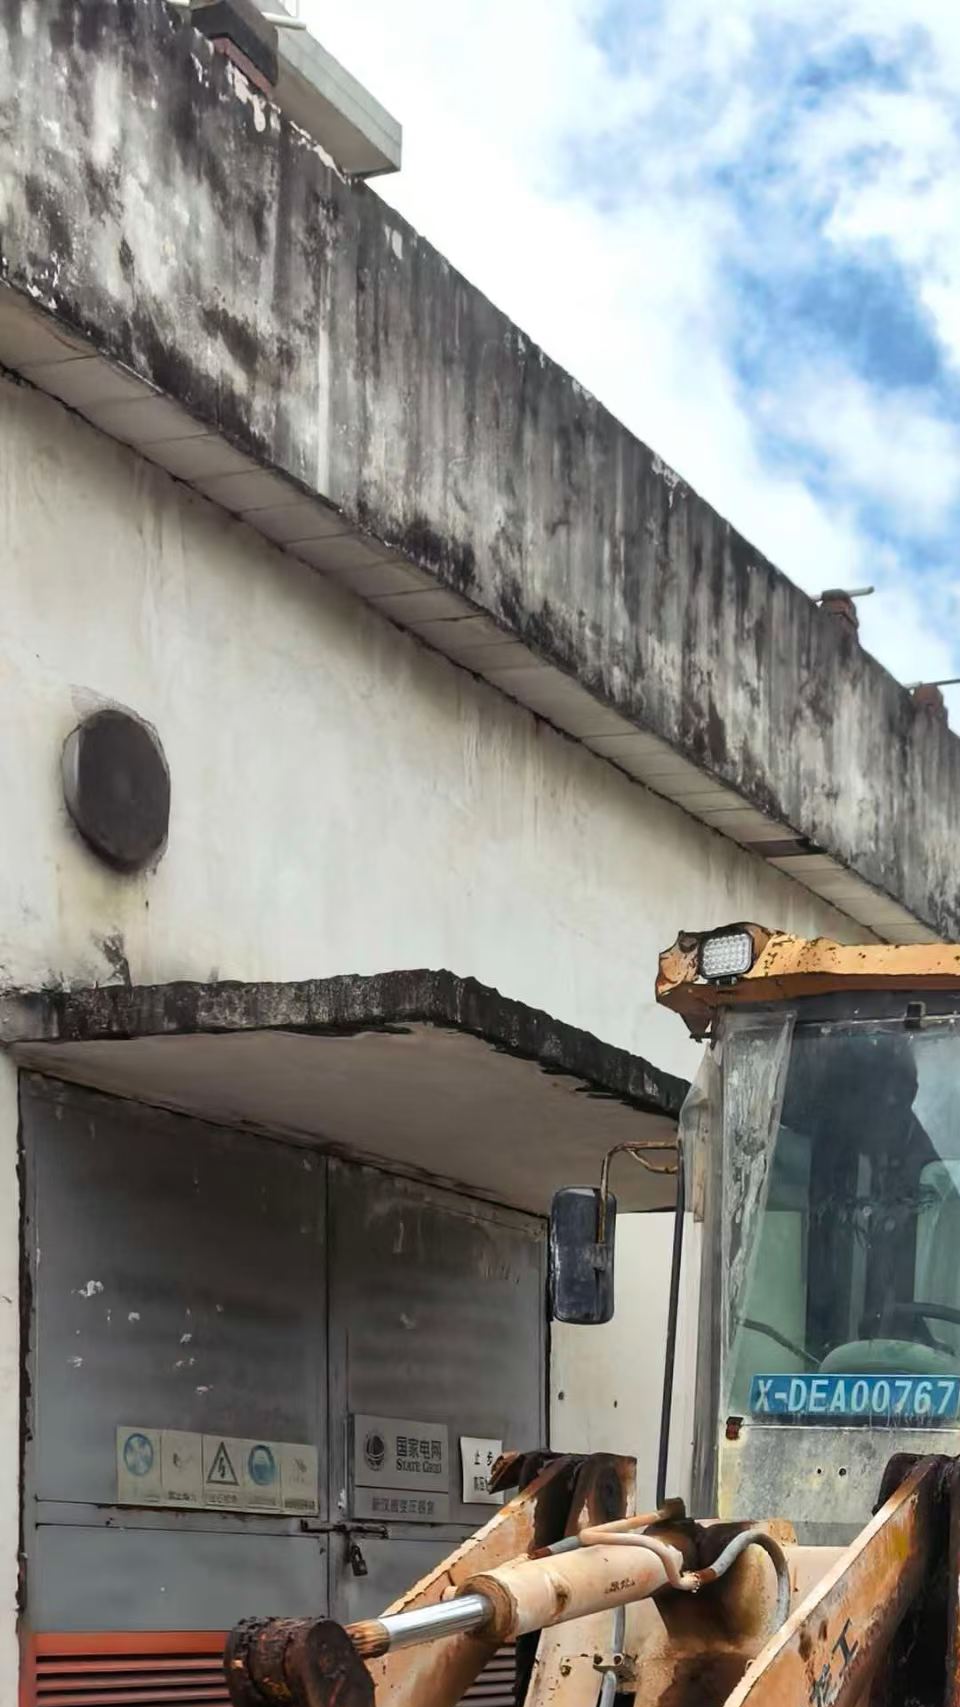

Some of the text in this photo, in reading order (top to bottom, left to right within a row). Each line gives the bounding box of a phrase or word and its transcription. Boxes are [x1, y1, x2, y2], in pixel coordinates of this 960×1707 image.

[754, 1378, 955, 1415] X-DEA00767
[396, 1436, 442, 1461] 国家电网
[396, 1458, 421, 1473] STATE
